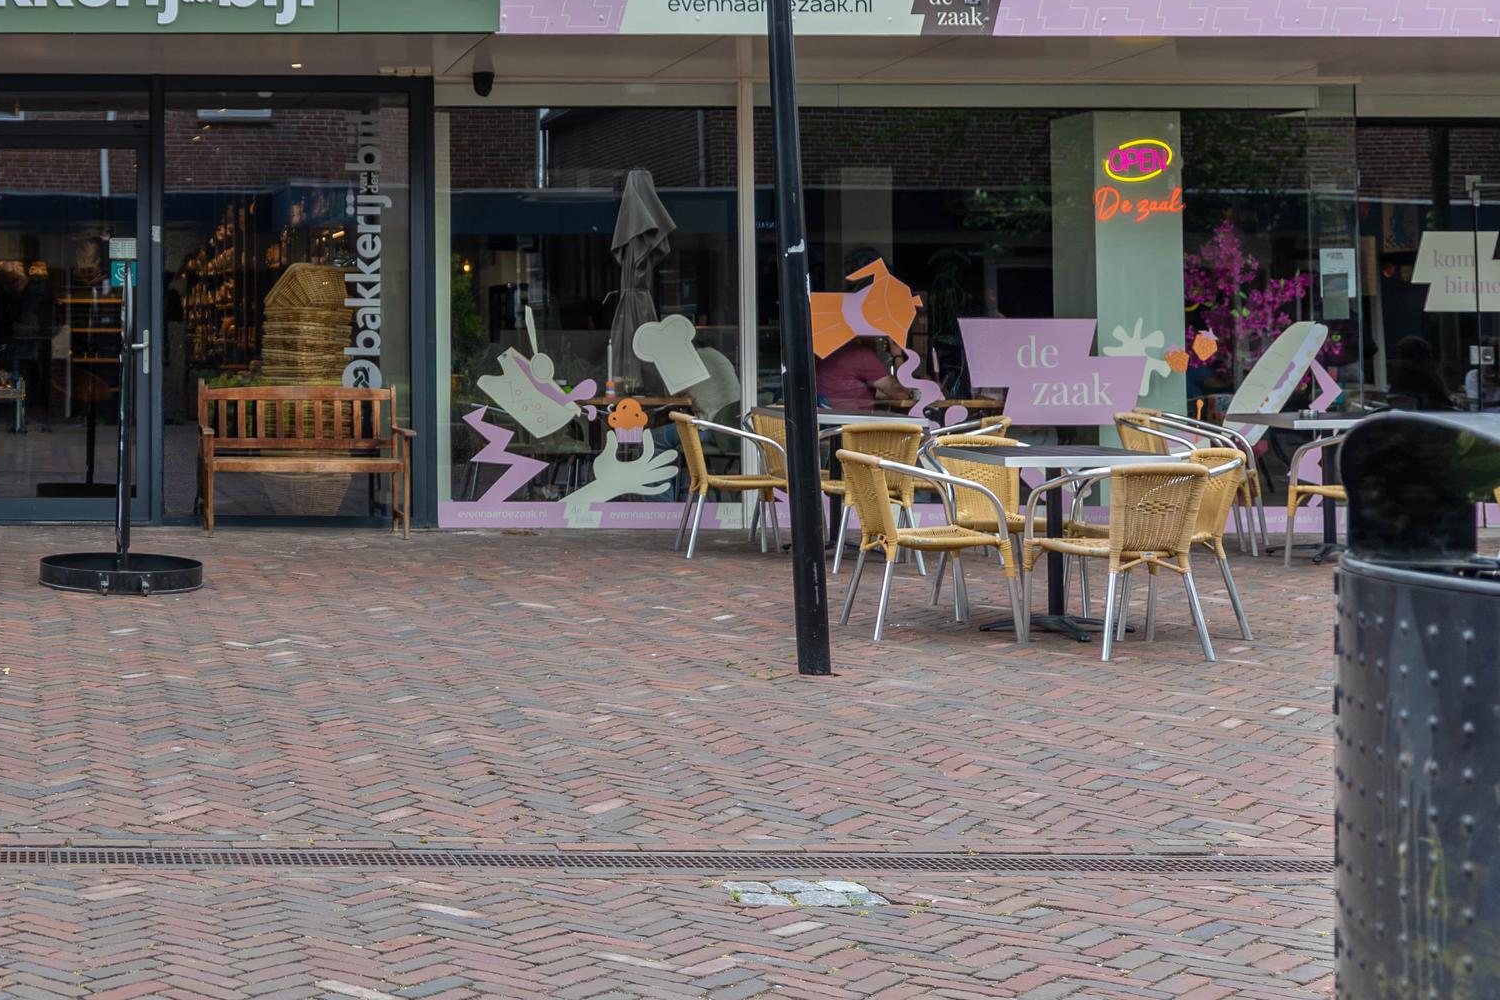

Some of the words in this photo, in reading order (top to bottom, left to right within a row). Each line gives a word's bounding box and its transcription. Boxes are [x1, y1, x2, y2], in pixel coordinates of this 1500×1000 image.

[937, 6, 984, 27] zaak
[1108, 147, 1168, 173] OPEN
[1094, 185, 1133, 222] De
[1133, 186, 1187, 223] zaak
[1432, 250, 1476, 268] kom
[344, 191, 392, 357] bakkerij
[1017, 335, 1059, 368] de
[1032, 372, 1114, 406] zaak
[457, 508, 548, 520] evennaardezaak.nl
